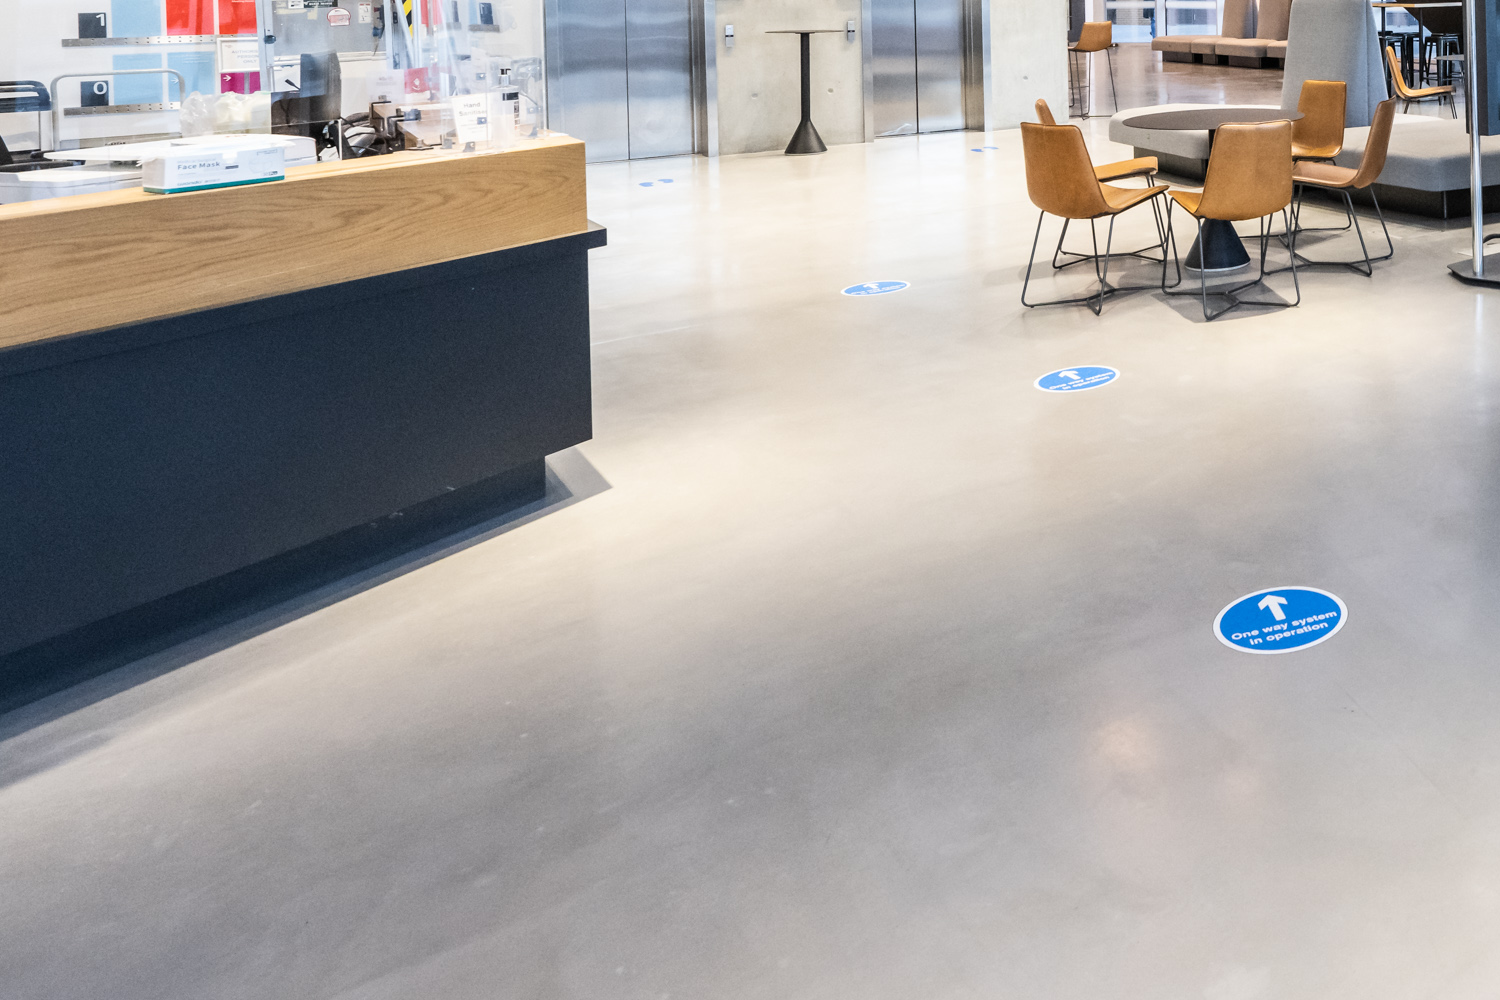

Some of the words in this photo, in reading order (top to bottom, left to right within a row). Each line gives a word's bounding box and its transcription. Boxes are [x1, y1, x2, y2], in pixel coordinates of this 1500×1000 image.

[96, 13, 106, 27] 1
[93, 82, 108, 95] 0
[1231, 630, 1260, 640] One
[1262, 622, 1288, 634] way
[1291, 611, 1338, 626] system
[1249, 636, 1263, 646] in
[1266, 622, 1329, 642] operation
